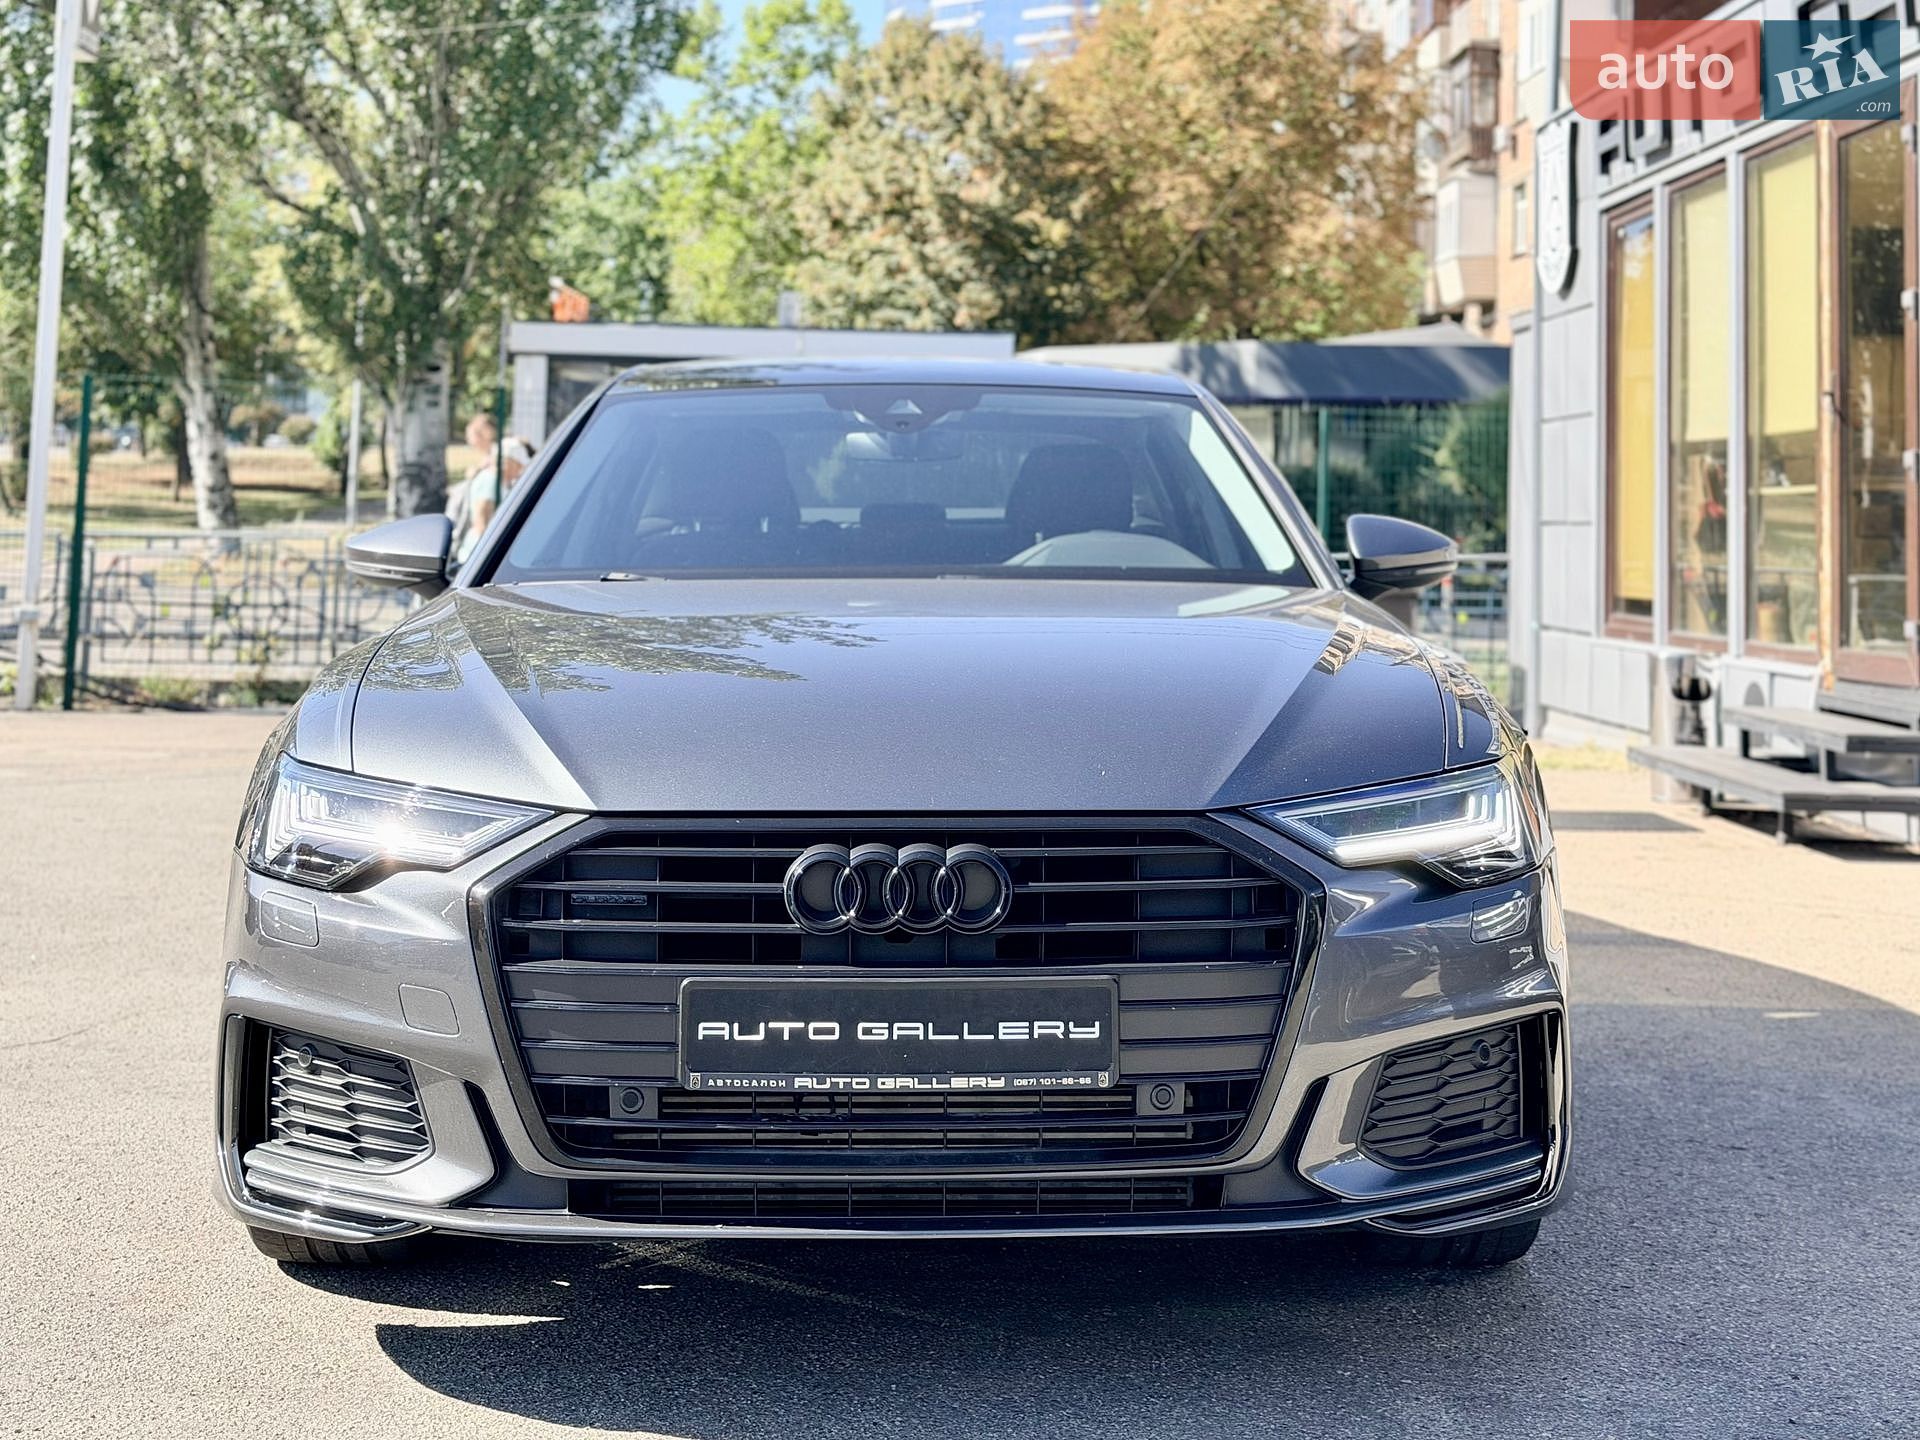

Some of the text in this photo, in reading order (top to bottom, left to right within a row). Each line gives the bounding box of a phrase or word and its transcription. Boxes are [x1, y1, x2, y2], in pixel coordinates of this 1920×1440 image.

[698, 1021, 1100, 1041] AUTO GALLERY
[793, 1077, 870, 1090] AUTO
[877, 1076, 1006, 1090] GALLERY
